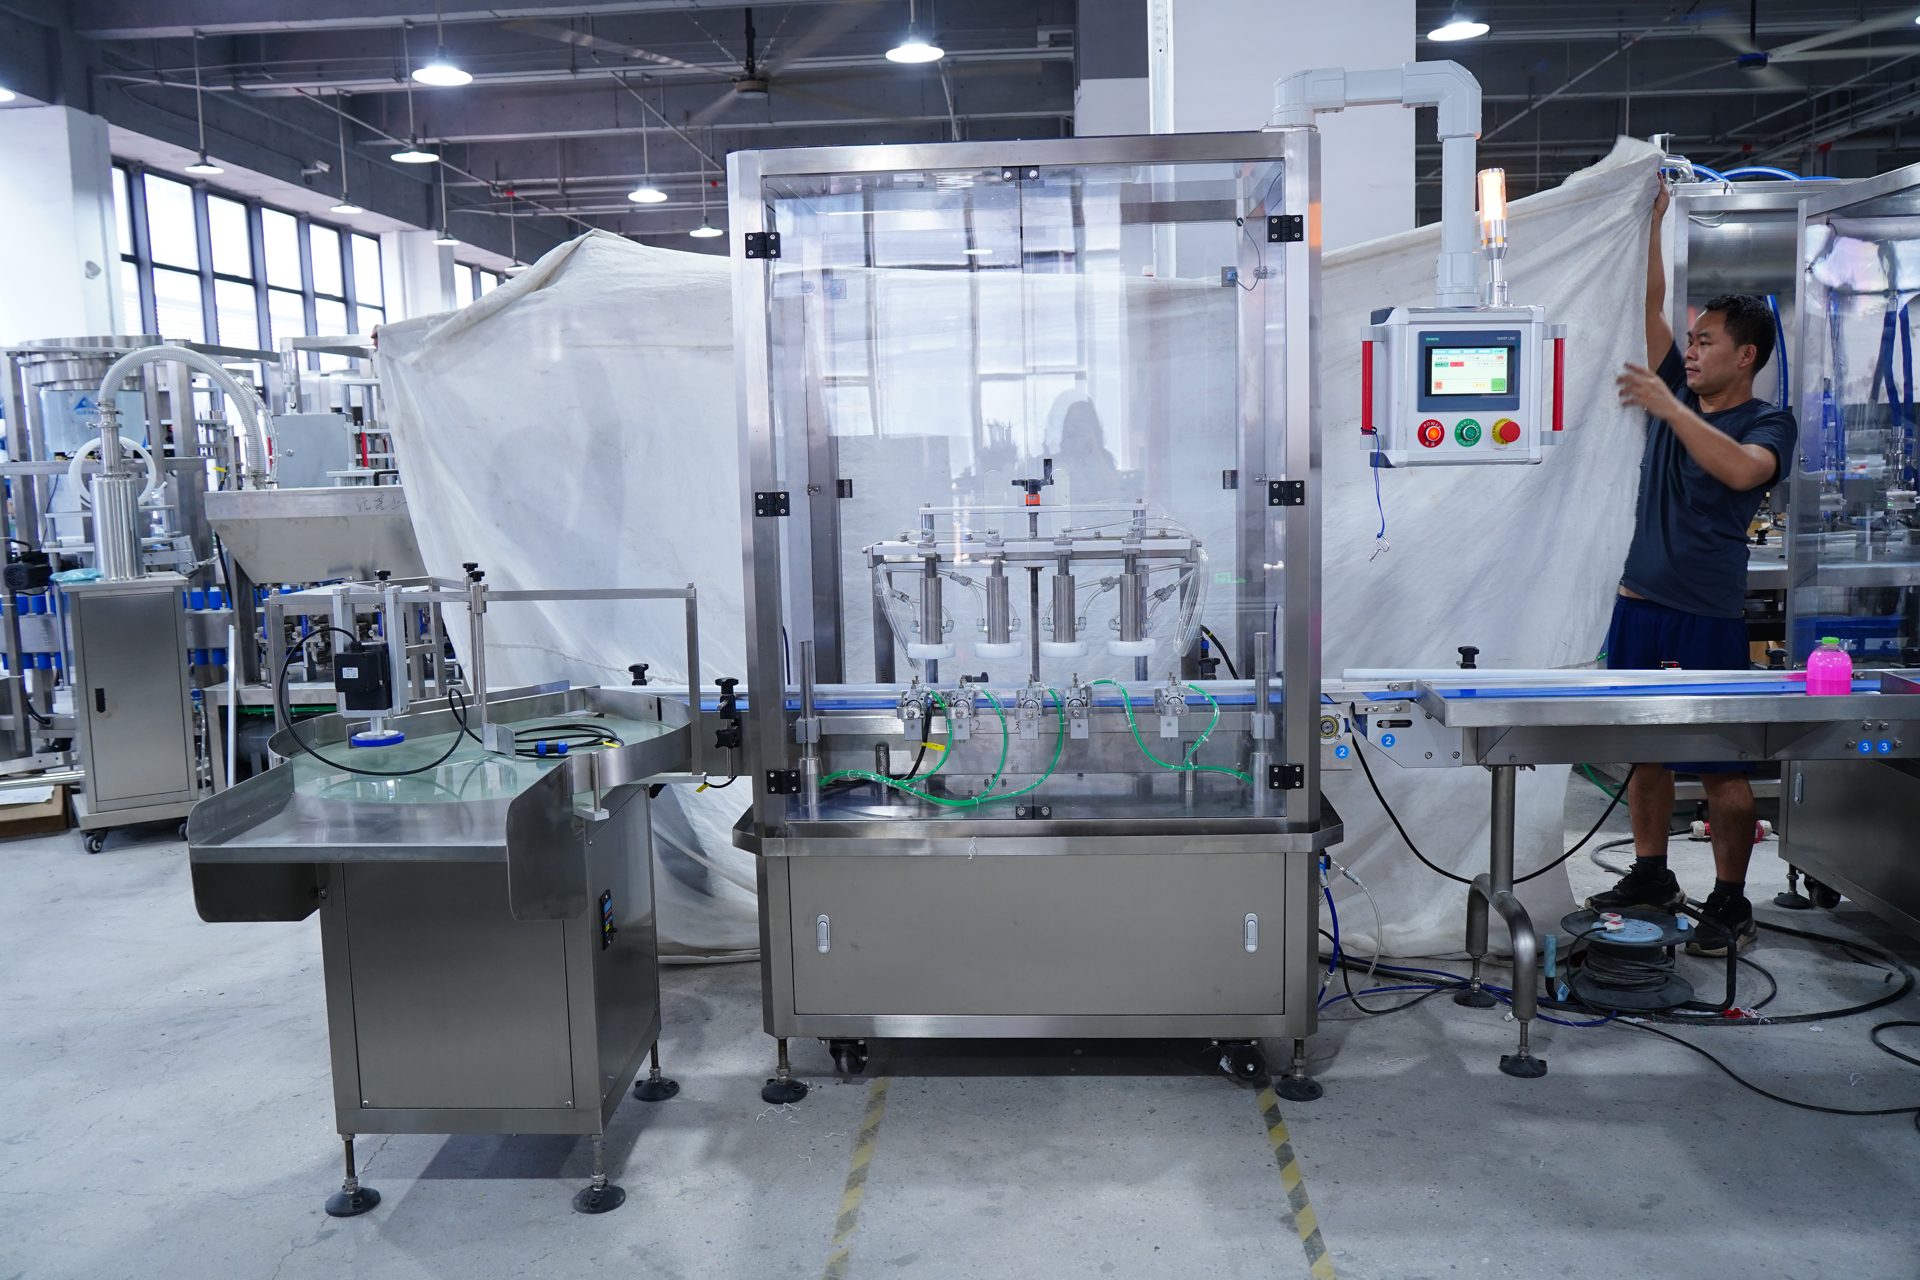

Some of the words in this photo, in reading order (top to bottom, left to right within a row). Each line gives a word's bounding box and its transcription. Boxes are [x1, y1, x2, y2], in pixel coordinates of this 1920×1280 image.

[1385, 736, 1392, 745] 2
[1862, 742, 1869, 751] 3
[1881, 742, 1888, 751] 3
[1340, 747, 1346, 757] 2
